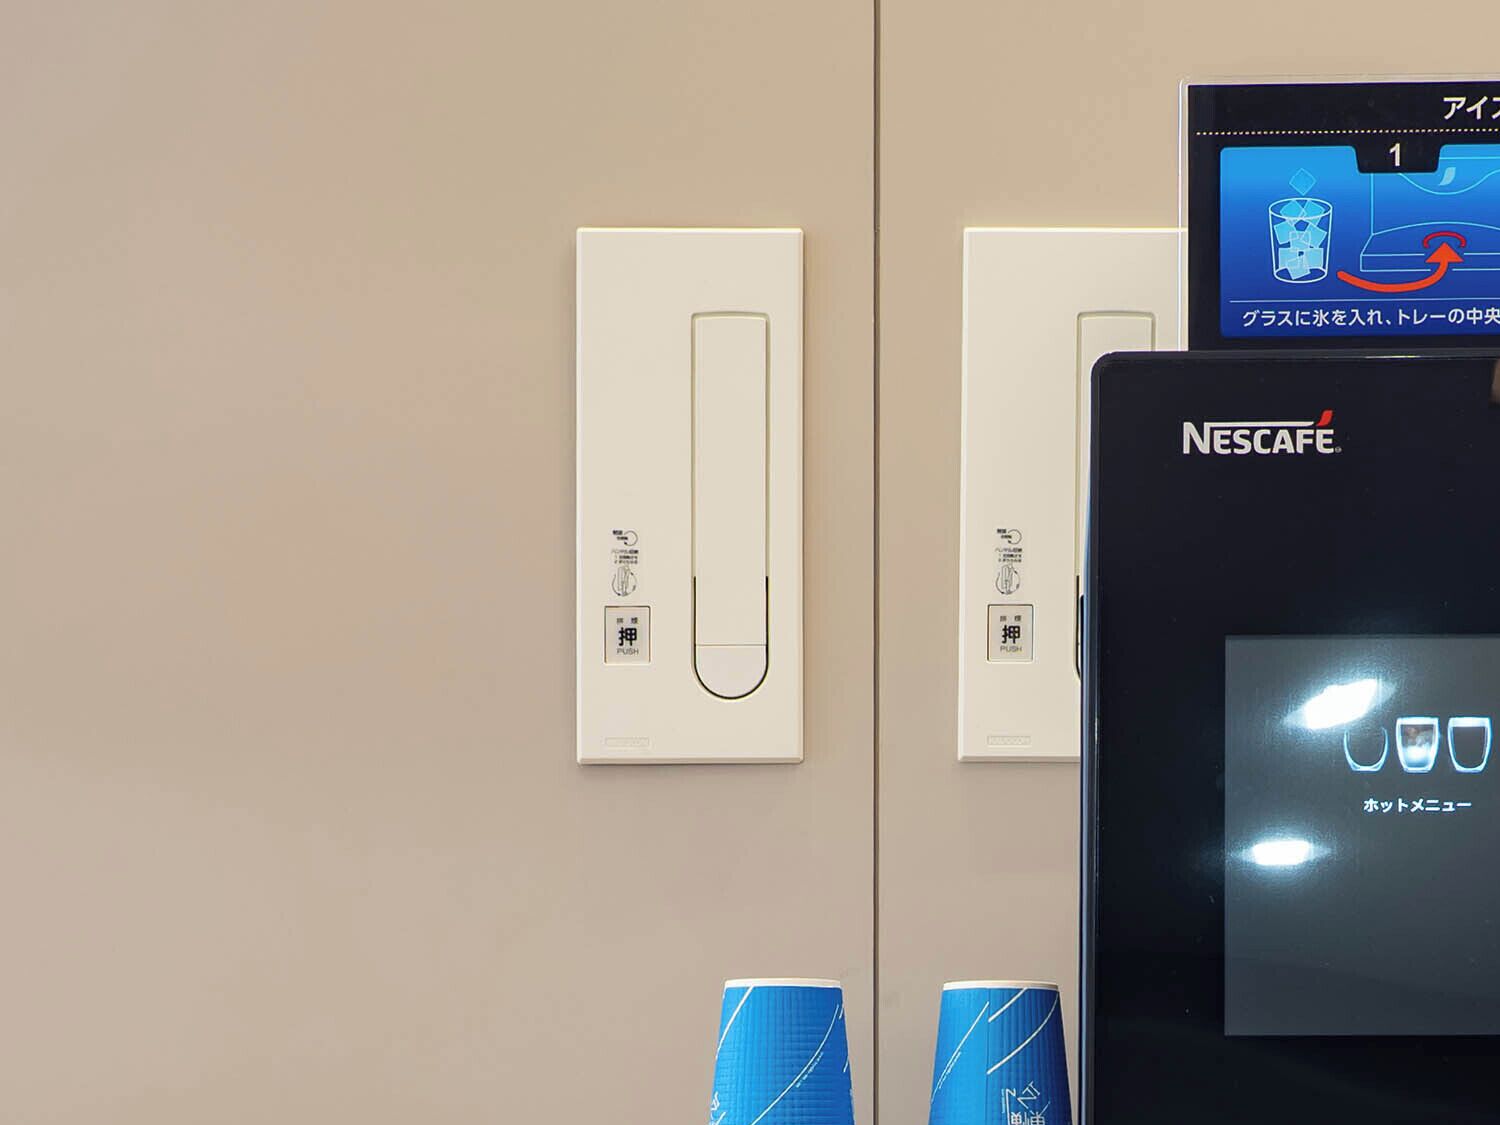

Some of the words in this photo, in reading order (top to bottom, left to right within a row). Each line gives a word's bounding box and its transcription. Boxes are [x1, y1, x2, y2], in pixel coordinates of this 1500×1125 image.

[1389, 143, 1401, 166] 1
[1183, 410, 1335, 454] NESCAFÉ
[618, 627, 637, 646] 押
[1002, 625, 1021, 644] 押
[1363, 798, 1472, 813] ホットメニュー
